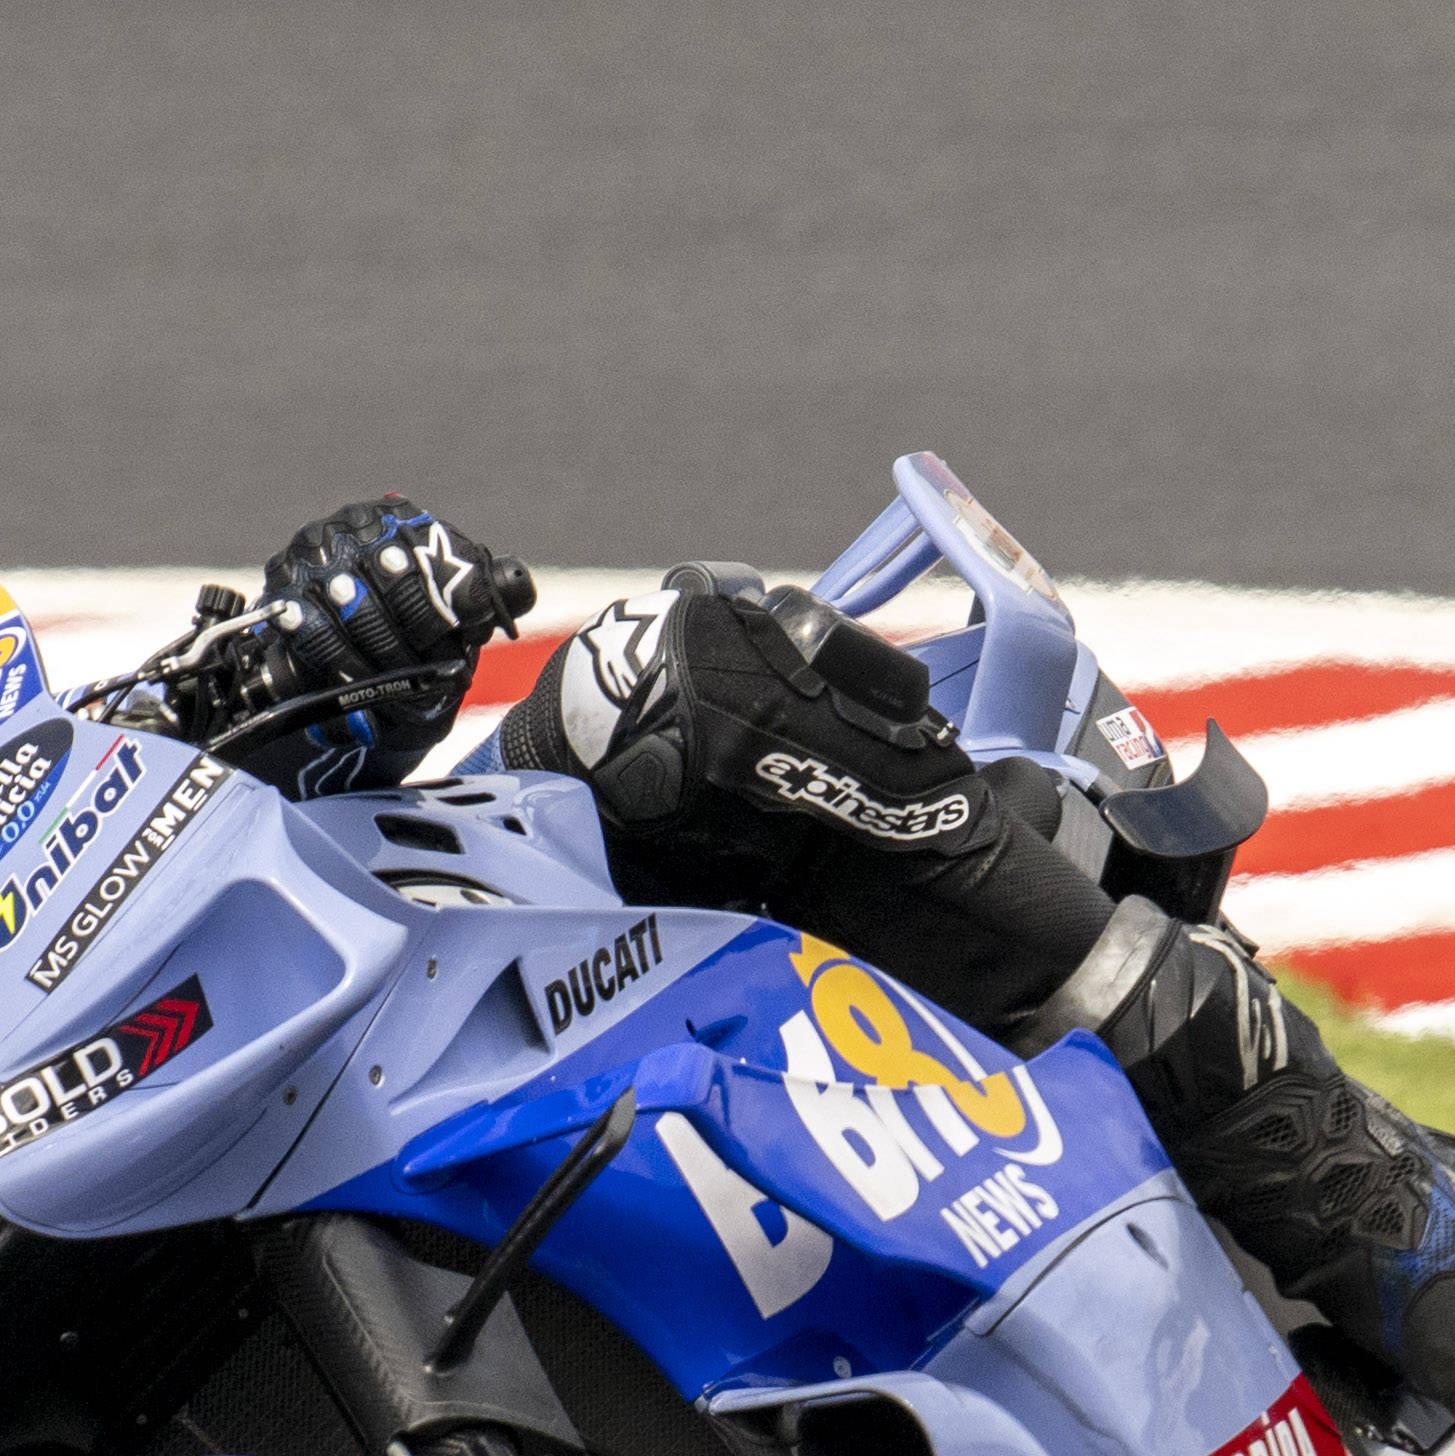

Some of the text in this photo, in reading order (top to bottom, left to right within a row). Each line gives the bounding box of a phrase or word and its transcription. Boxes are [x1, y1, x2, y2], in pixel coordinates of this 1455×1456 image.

[338, 679, 411, 706] MOTO-TRON
[755, 753, 969, 840] alpinestars
[30, 935, 79, 987] MS
[72, 840, 151, 936] GLOW
[152, 756, 225, 837] MEN
[544, 913, 664, 1038] DUCATI
[940, 1164, 1059, 1268] NEWS
